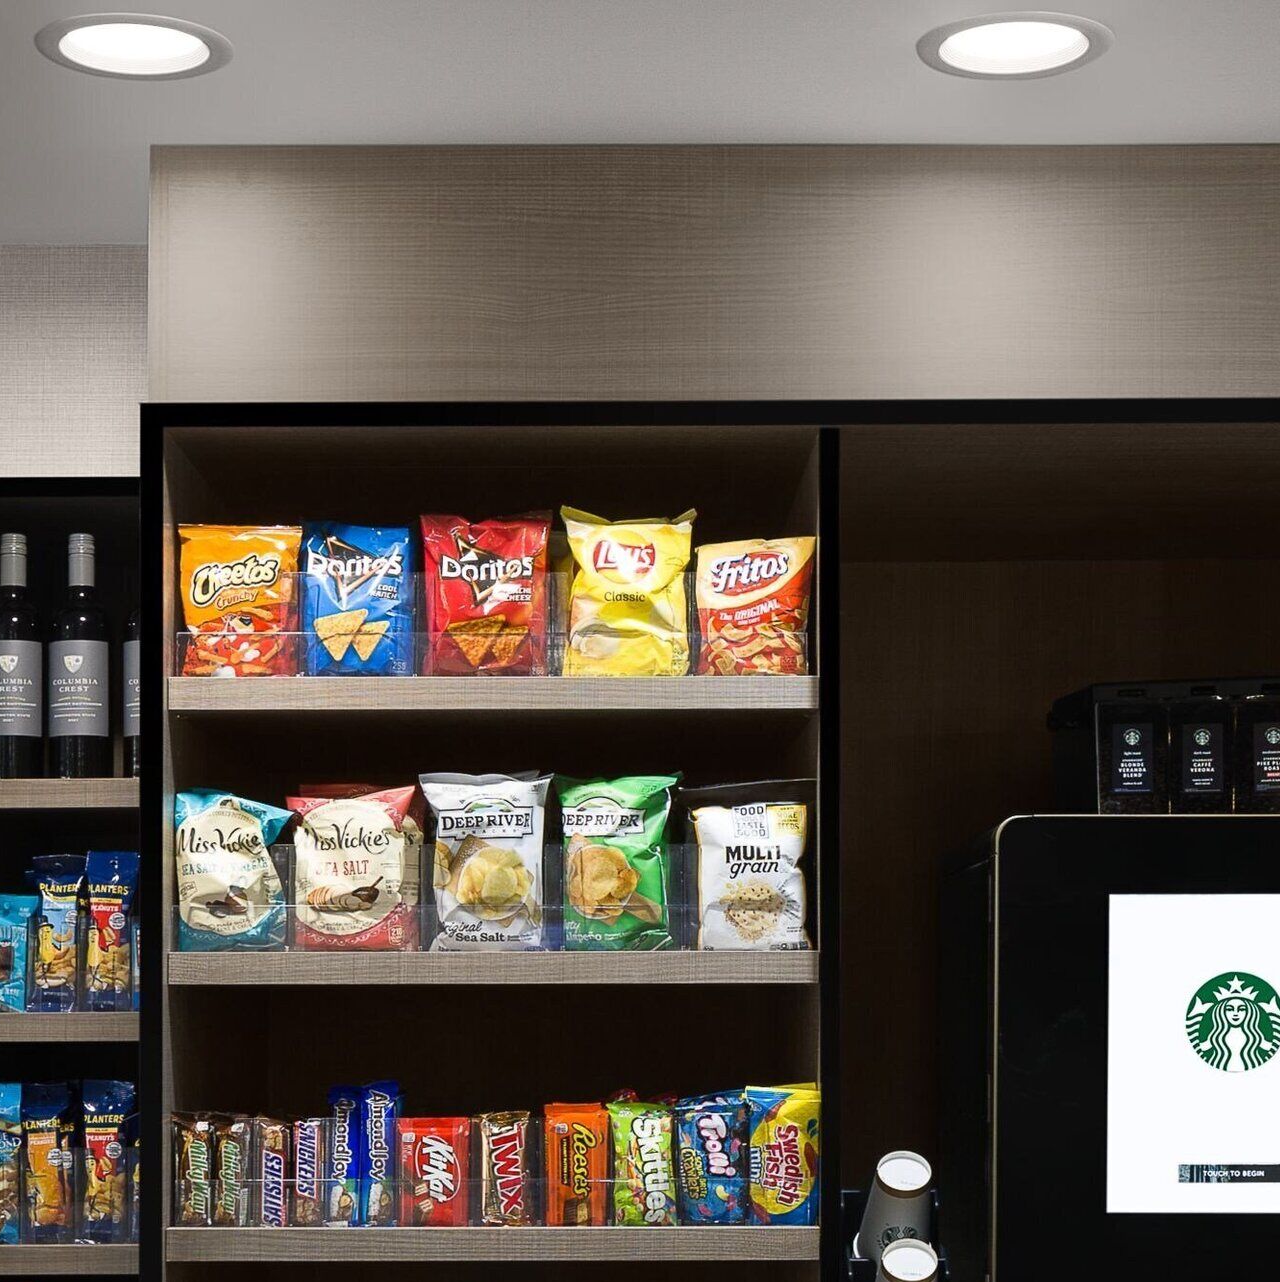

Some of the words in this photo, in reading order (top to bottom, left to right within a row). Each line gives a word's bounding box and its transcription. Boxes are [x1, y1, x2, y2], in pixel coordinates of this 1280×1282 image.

[307, 552, 404, 577] Doritos
[440, 555, 535, 581] Doritos
[597, 541, 653, 570] Lay's
[710, 552, 790, 593] Fritos
[193, 555, 279, 606] Cheetos
[604, 591, 646, 602] Classic
[216, 589, 259, 610] Crunchy
[734, 599, 781, 620] ORIGINAL
[52, 678, 99, 686] COLUMBIA
[335, 817, 391, 854] Vickie's
[441, 814, 484, 831] DEEP
[489, 812, 531, 829] RIVER
[596, 813, 640, 828] RIVER
[178, 827, 216, 854] Miss
[343, 860, 370, 876] SALT
[729, 861, 780, 880] grain
[455, 932, 478, 943] Sea
[480, 931, 505, 943] Salt
[187, 1139, 209, 1183] Milky
[220, 1140, 241, 1183] Milky
[296, 1119, 319, 1200] SNICKERS
[571, 1122, 599, 1198] Reese's
[697, 1114, 737, 1178] Trolli
[488, 1122, 526, 1215] TWIX
[630, 1116, 671, 1224] Skittles
[749, 1146, 762, 1185] mini
[762, 1142, 784, 1190] Fish
[776, 1123, 805, 1206] Swedish
[191, 1178, 209, 1214] Way
[261, 1150, 285, 1228] SATISFIES
